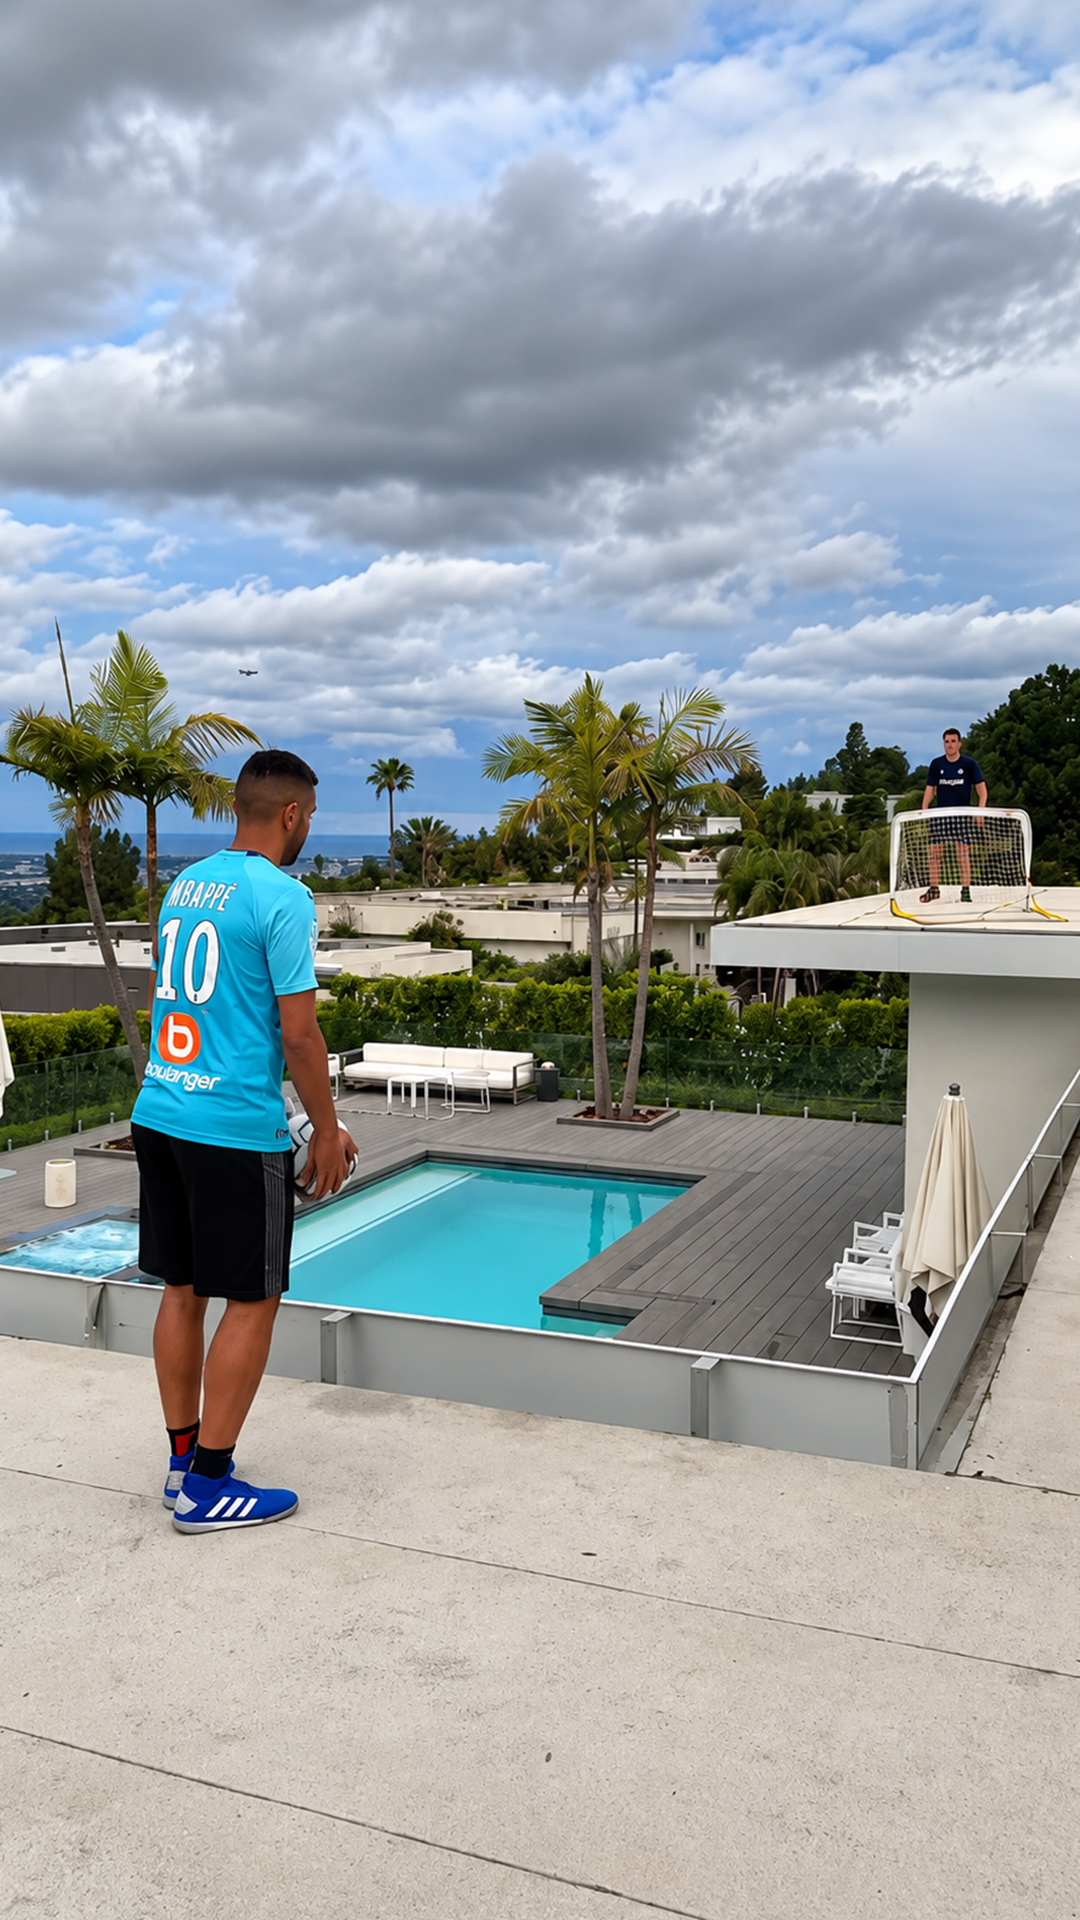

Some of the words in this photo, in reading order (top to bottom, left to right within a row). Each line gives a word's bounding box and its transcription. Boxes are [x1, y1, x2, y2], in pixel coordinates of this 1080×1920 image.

[167, 879, 237, 912] MBAPPÉ
[156, 918, 220, 1005] 10
[167, 1015, 194, 1058] b
